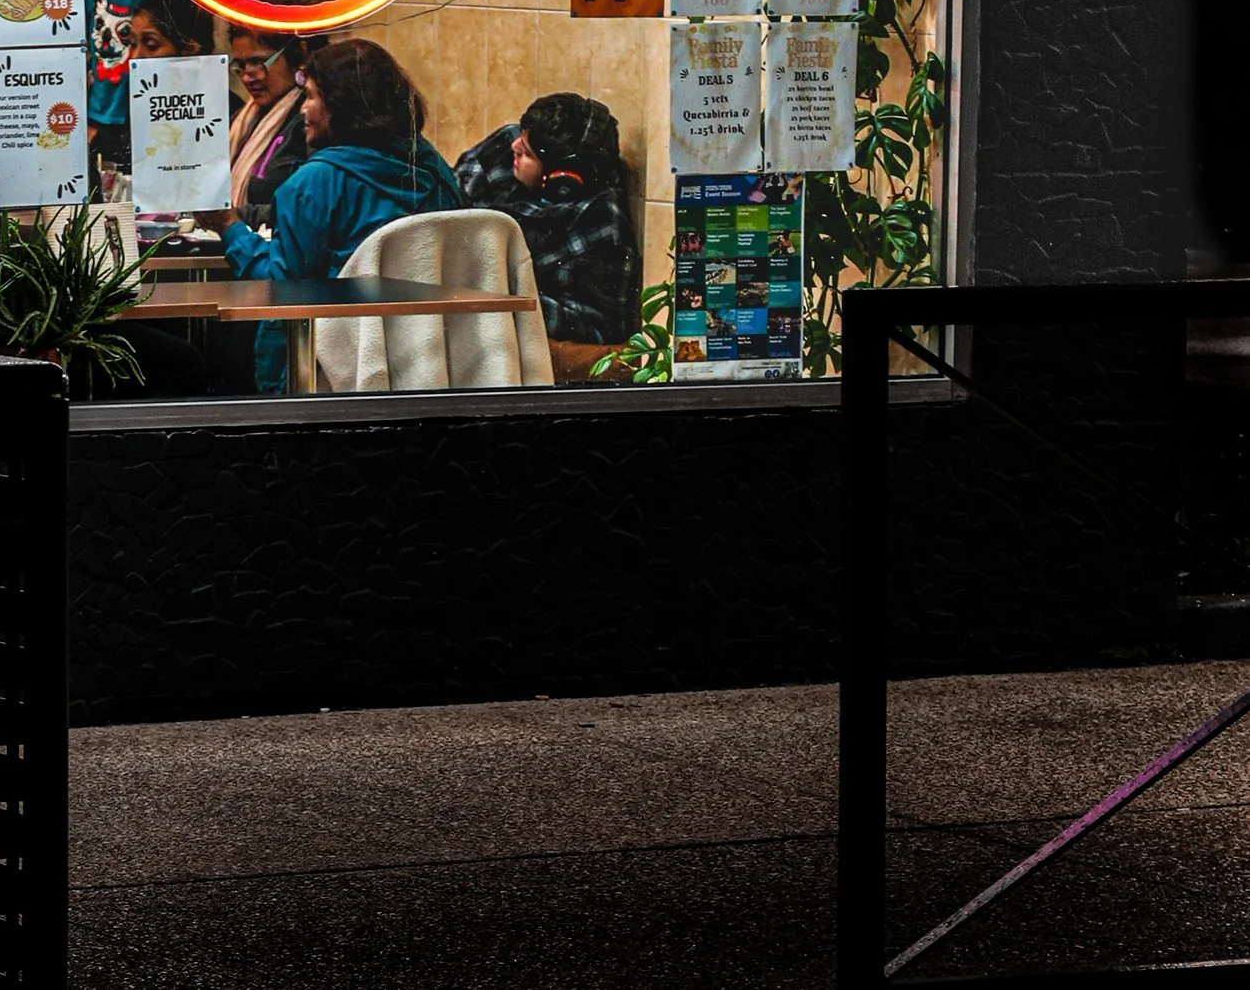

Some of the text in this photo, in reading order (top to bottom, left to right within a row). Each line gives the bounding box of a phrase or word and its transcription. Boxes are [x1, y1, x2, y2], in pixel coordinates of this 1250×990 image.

[5, 72, 64, 87] ESQUITES
[699, 75, 733, 86] DEAL 5
[795, 71, 829, 82] DEAL 6
[150, 93, 205, 109] STUDENT
[703, 94, 728, 106] 5 sets
[25, 113, 37, 121] cup
[51, 114, 73, 125] $10
[683, 108, 750, 120] Quesabirria &
[718, 123, 745, 135] drink
